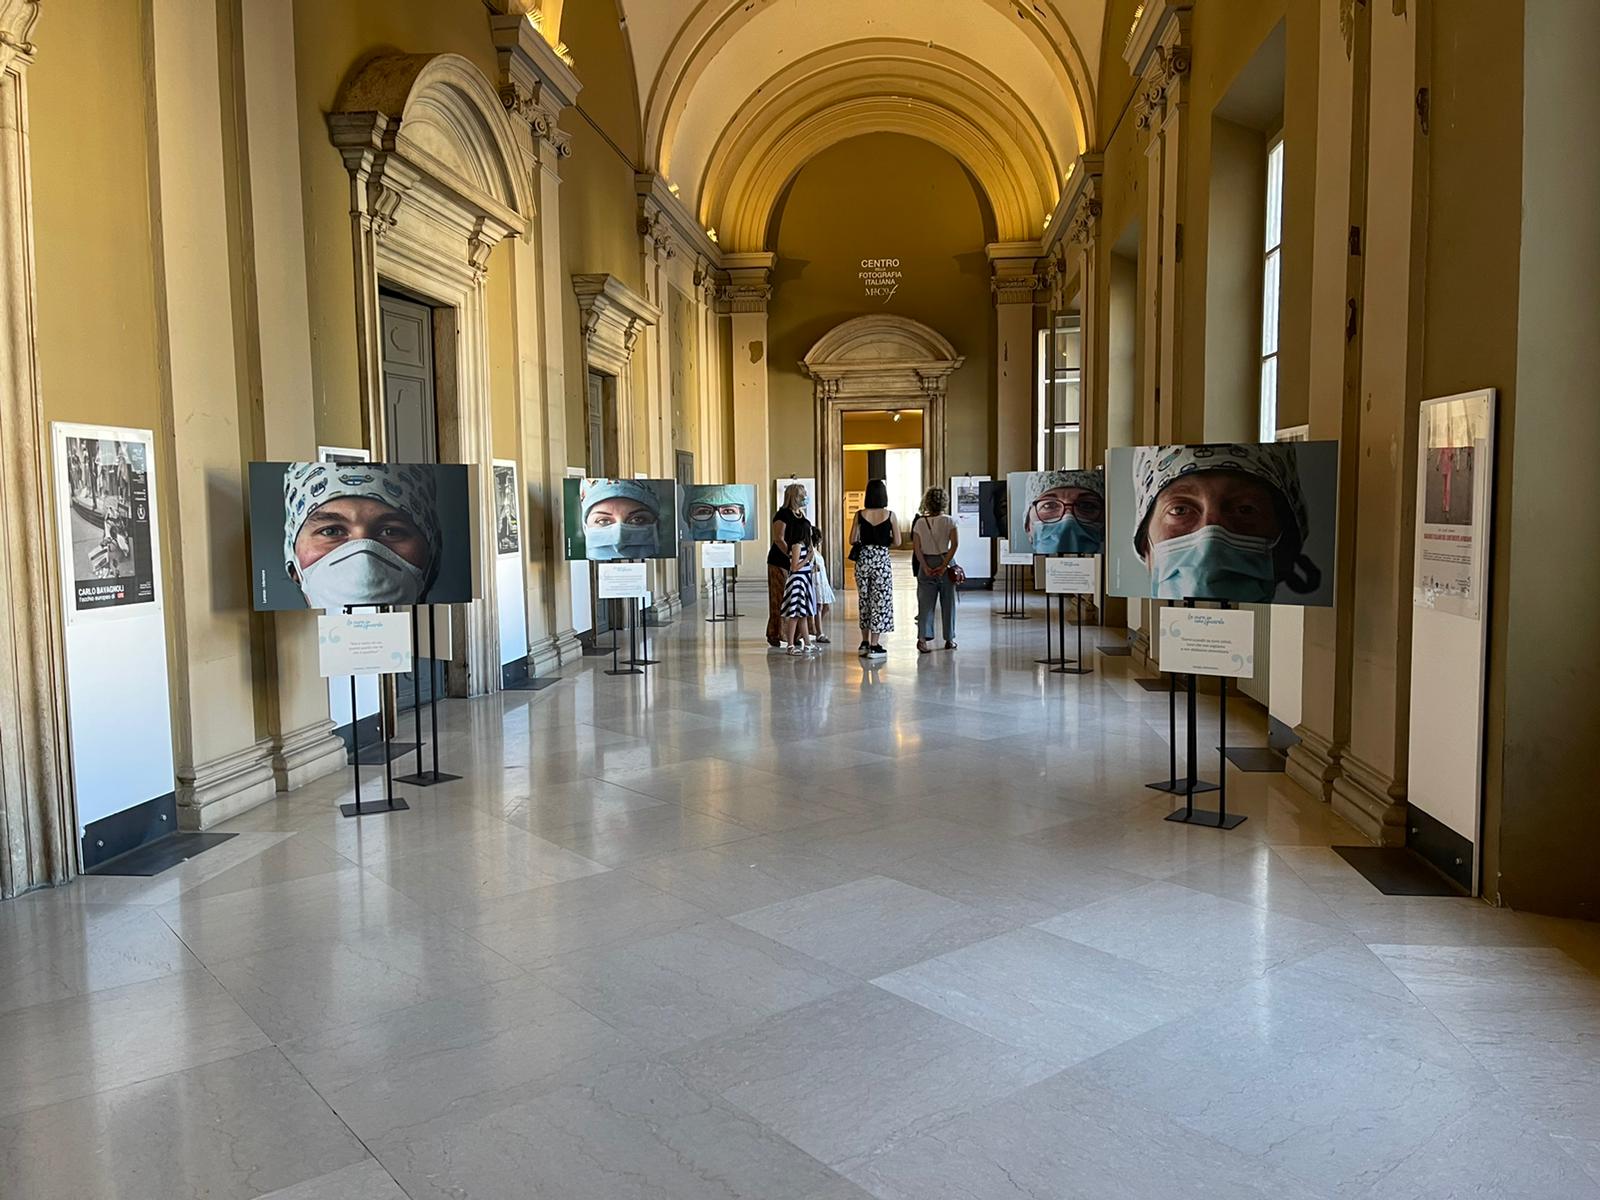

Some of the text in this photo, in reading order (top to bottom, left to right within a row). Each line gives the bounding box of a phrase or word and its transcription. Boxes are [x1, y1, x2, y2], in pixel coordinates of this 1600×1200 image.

[861, 259, 900, 268] CENTRO
[859, 271, 902, 279] FOTOGRAFIA
[78, 587, 96, 597] CARLO
